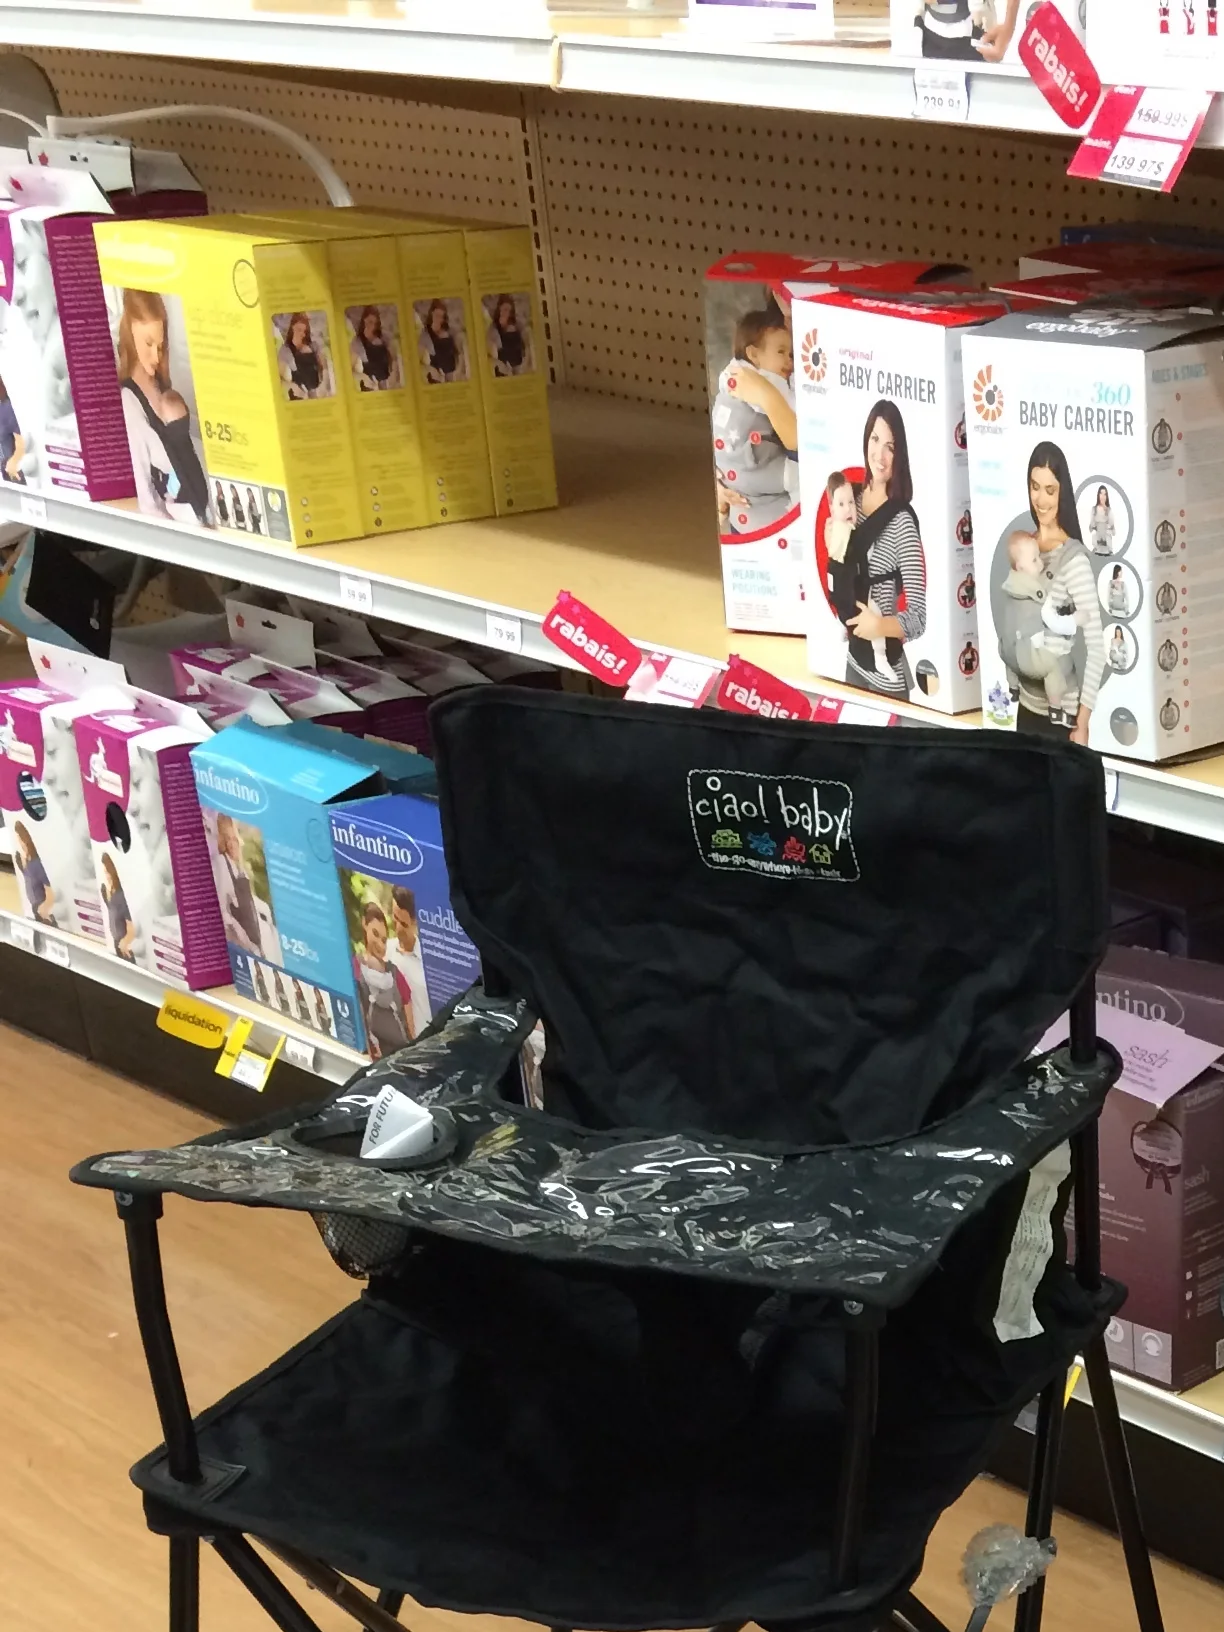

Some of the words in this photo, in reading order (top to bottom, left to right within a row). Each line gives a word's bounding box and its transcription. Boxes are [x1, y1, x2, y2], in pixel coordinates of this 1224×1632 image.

[1027, 28, 1089, 113] rabais!
[839, 362, 872, 392] BABY
[876, 370, 937, 405] CARRIER
[1090, 381, 1132, 407] 360
[1019, 400, 1058, 429] BABY
[1064, 405, 1134, 437] CARRIER
[549, 612, 627, 676] rabais!
[193, 762, 260, 805] infantino
[695, 775, 771, 825] ciao!
[777, 784, 848, 851] baby
[331, 819, 412, 866] infantino
[164, 1004, 223, 1035] liquidation
[1124, 1045, 1170, 1069] sash
